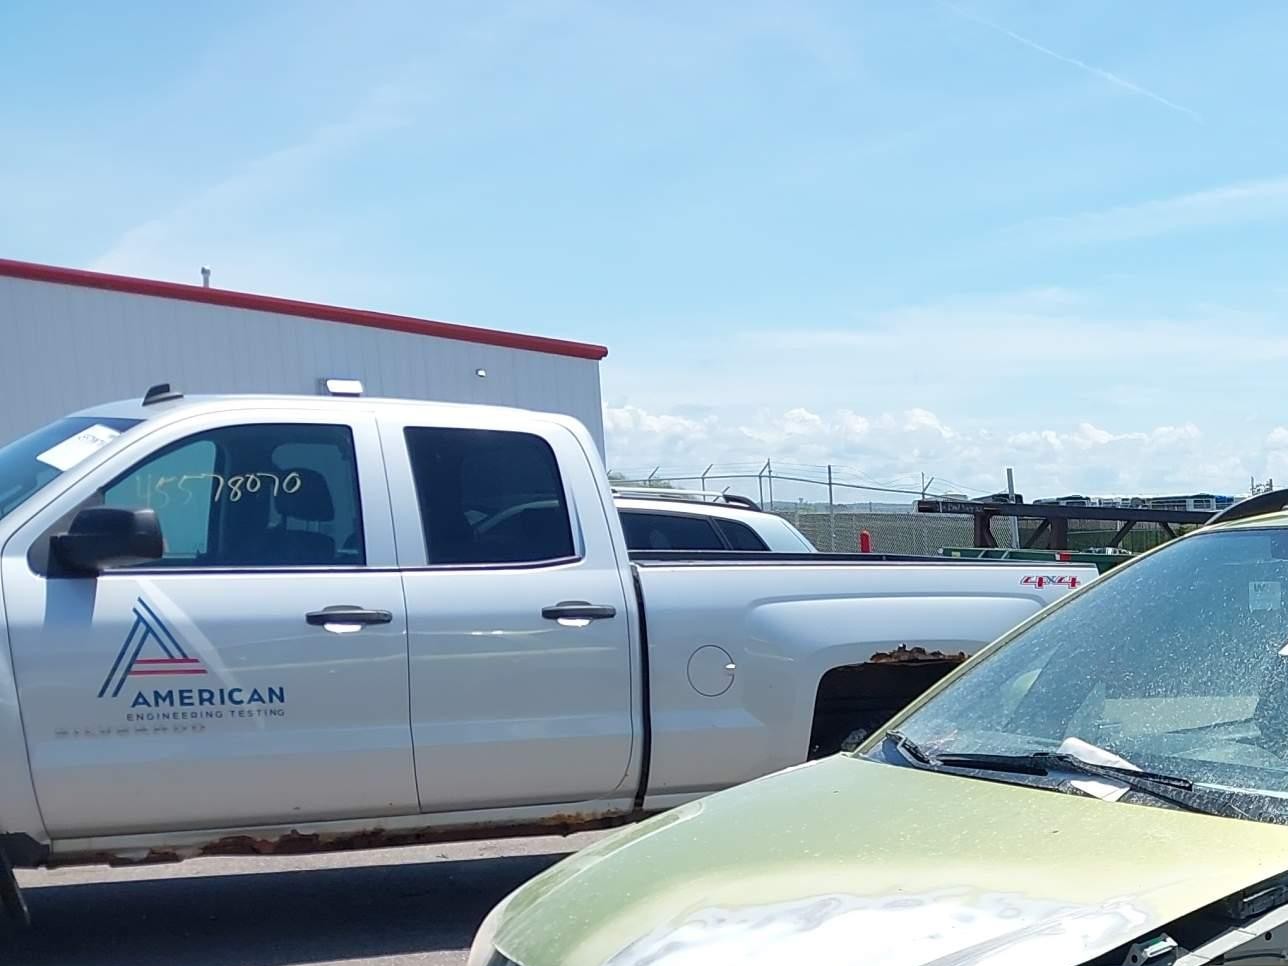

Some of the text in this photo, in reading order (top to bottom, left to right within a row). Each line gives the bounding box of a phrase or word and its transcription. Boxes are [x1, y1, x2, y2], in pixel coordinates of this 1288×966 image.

[131, 686, 286, 709] AMERICAN
[126, 708, 286, 722] ENGINEERING TESTING
